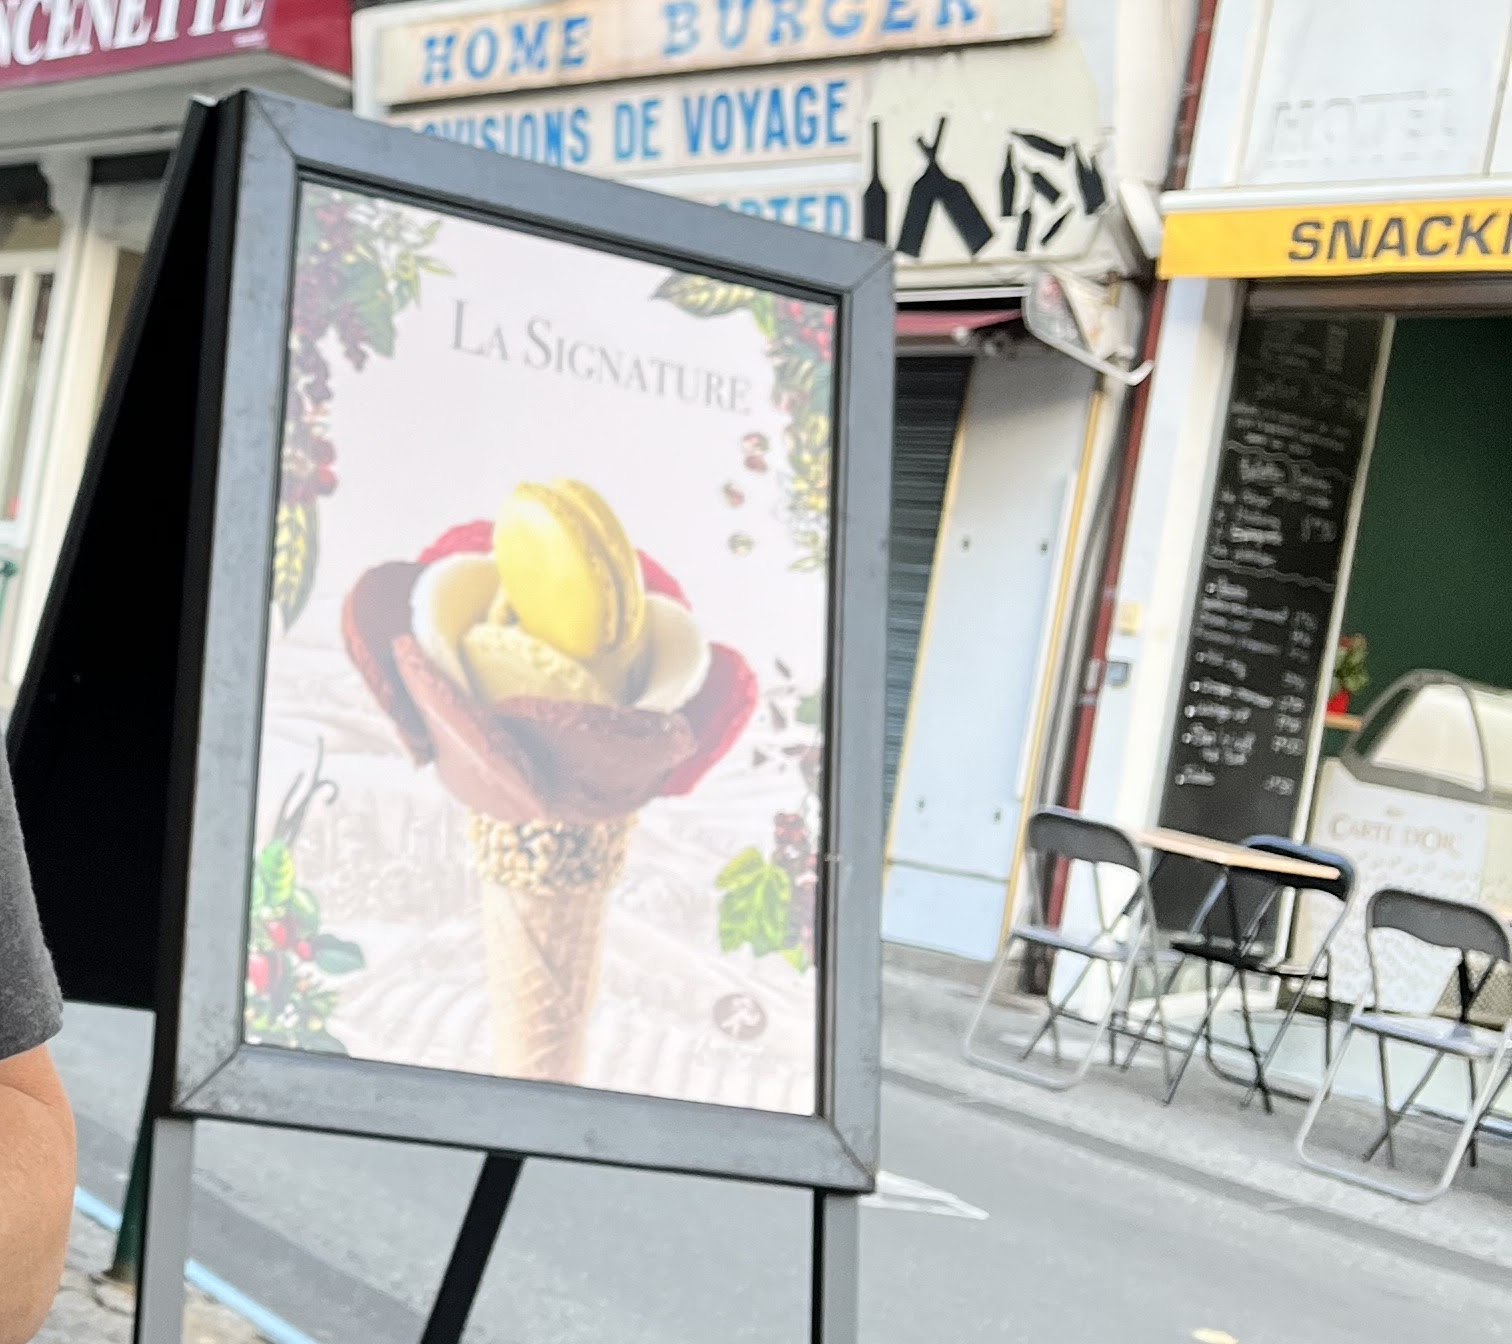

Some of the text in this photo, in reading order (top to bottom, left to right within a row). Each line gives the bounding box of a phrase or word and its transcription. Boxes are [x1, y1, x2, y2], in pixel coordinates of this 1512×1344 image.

[420, 14, 592, 86] HOME
[614, 98, 661, 159] DE
[682, 79, 848, 155] VOYAGE
